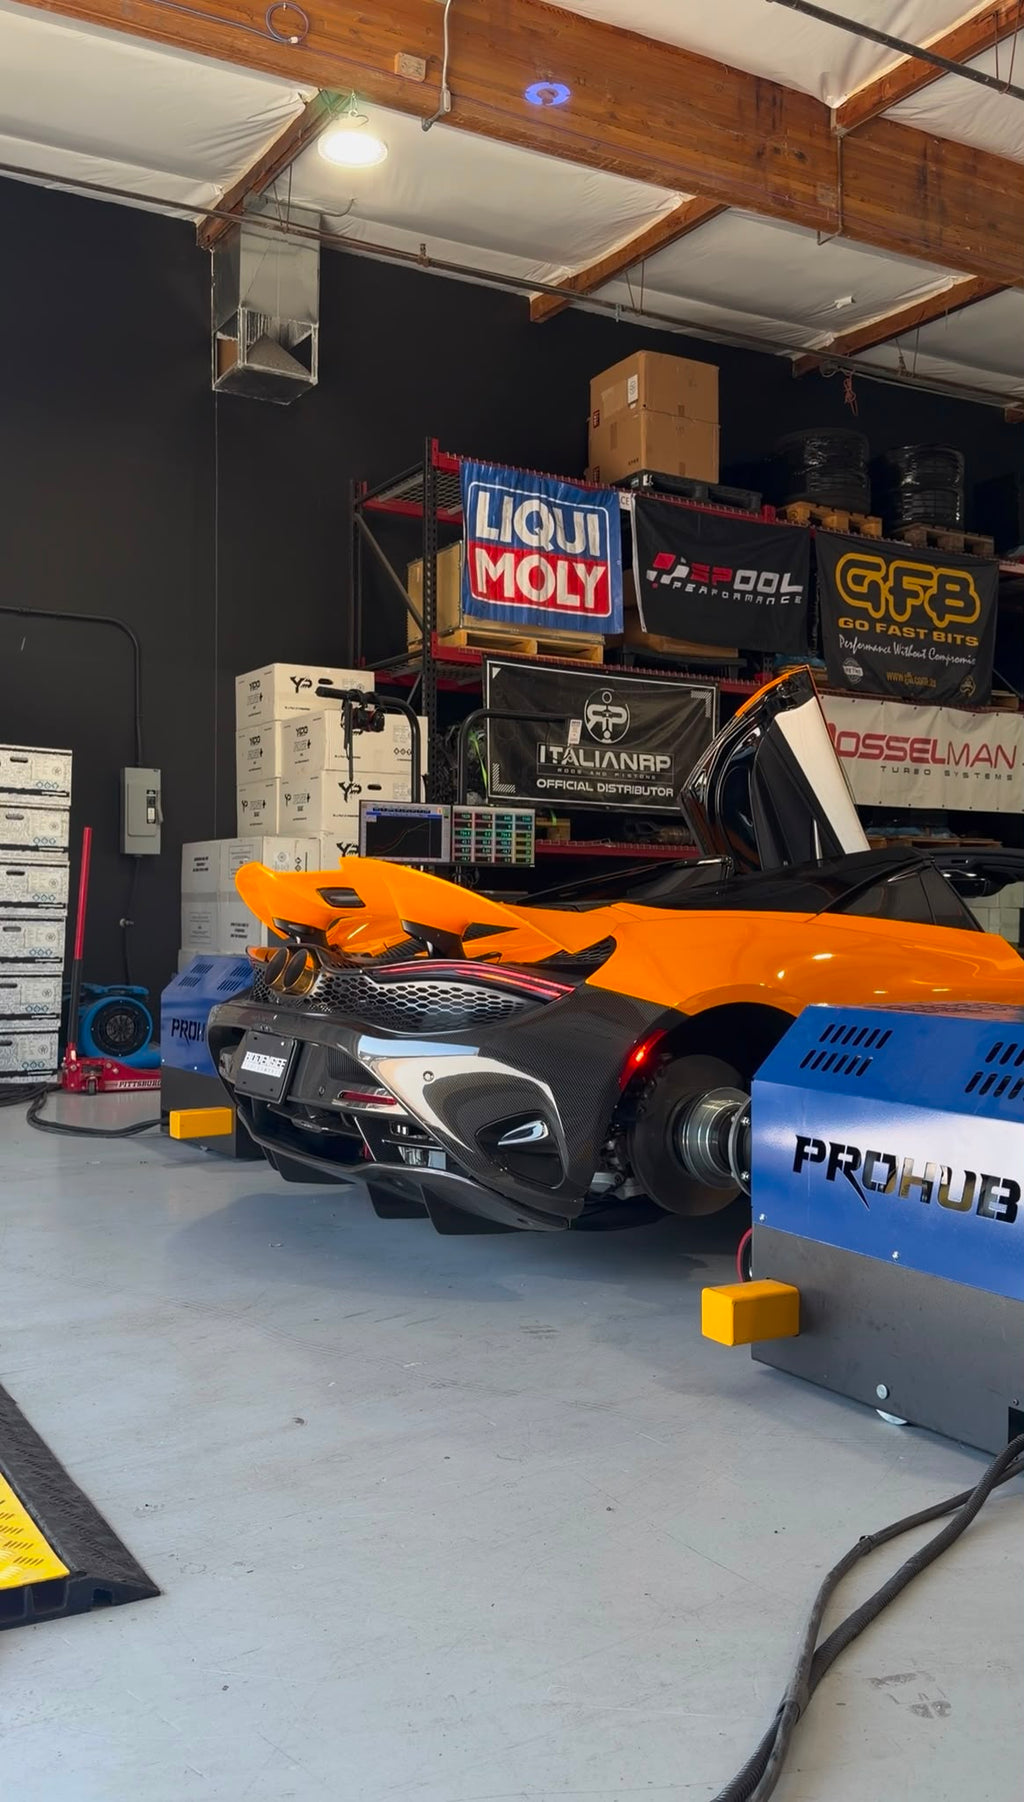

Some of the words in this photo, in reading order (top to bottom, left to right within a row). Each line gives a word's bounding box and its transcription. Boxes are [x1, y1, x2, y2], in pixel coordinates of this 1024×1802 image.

[476, 491, 600, 556] LIQUI
[475, 548, 606, 609] MOLY
[835, 552, 981, 628] GFB
[672, 581, 802, 605] PERFORMANCE
[838, 617, 869, 631] GO
[876, 622, 928, 640] FAST
[932, 631, 979, 647] BITS
[839, 634, 891, 654] Performance
[893, 642, 927, 659] Without
[540, 745, 672, 772] ITALIANRP
[557, 767, 582, 775] RODS
[881, 766, 932, 776] TURBO
[944, 770, 1013, 781] SYSTEMS
[536, 778, 594, 792] OFFICIAL
[597, 784, 674, 797] DISTRIBUTOR
[792, 1135, 1022, 1224] PROHUB
